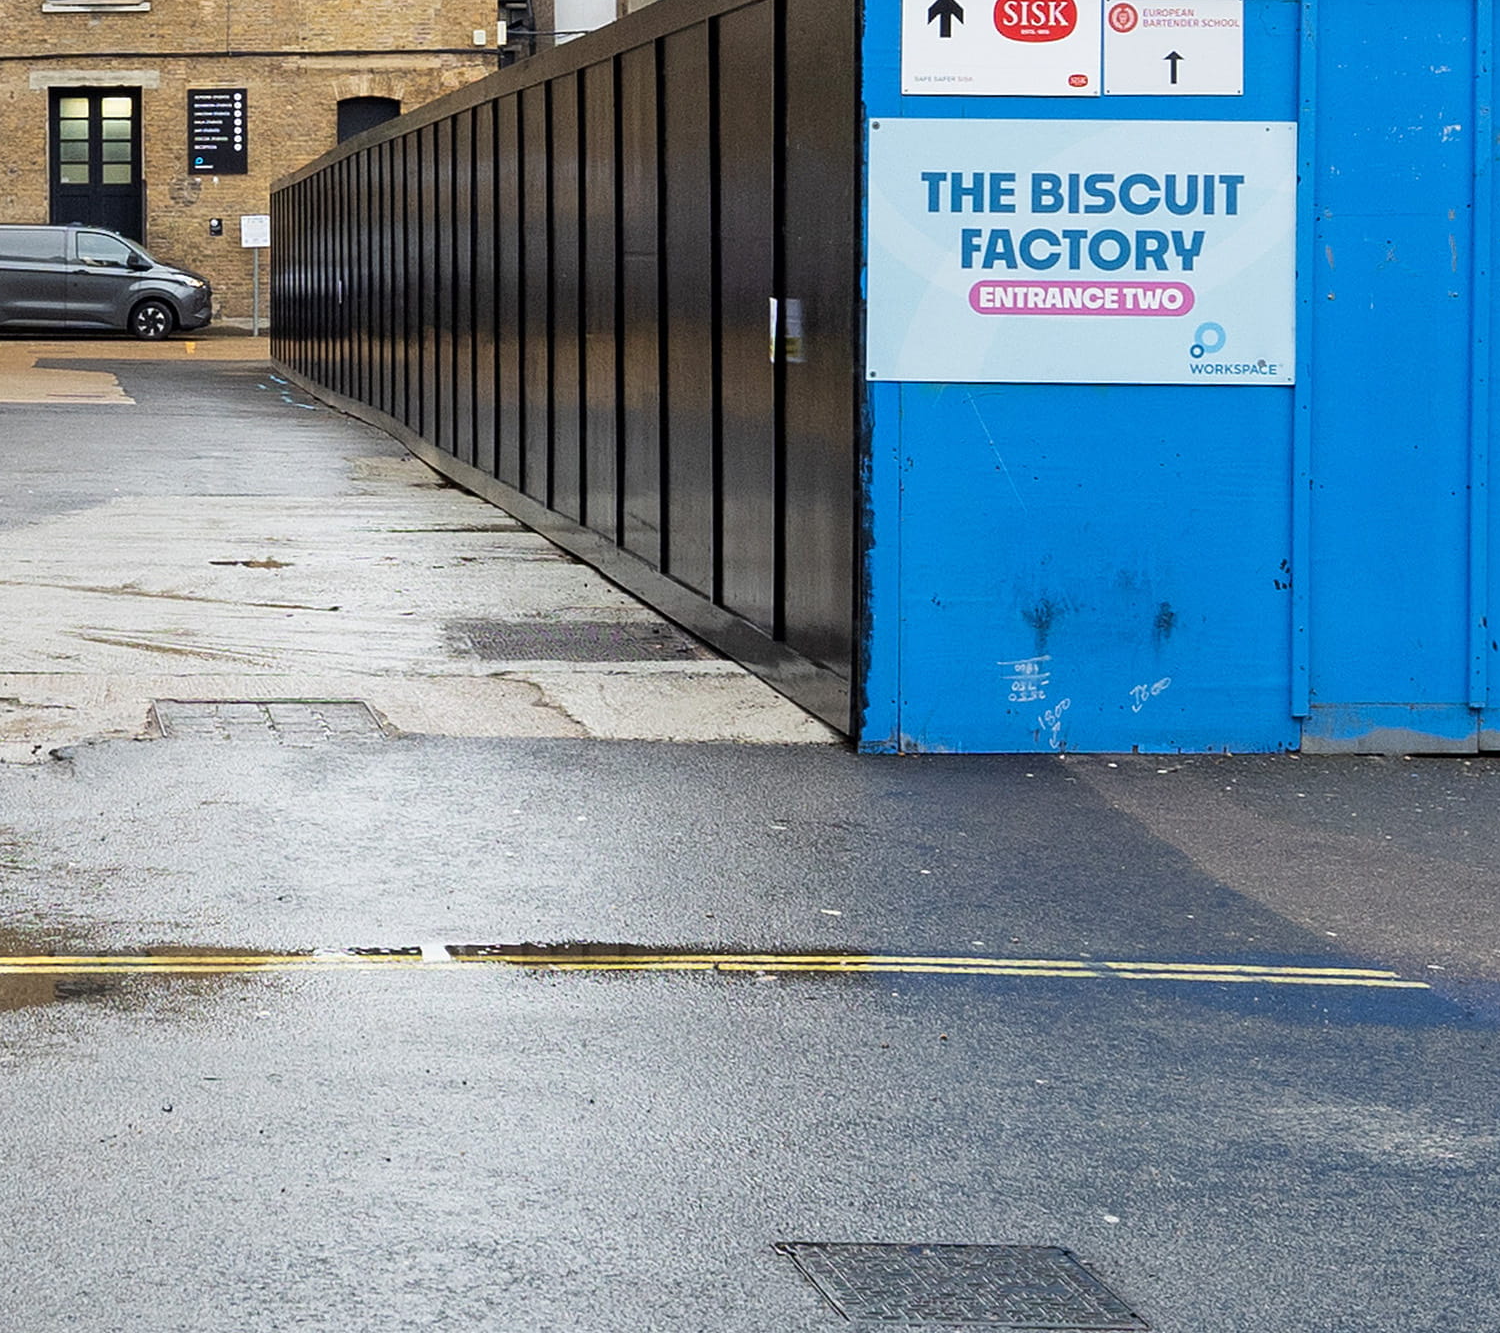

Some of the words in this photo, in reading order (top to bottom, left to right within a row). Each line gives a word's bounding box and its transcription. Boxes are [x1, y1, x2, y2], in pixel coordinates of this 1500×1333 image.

[1002, 0, 1070, 27] SISK
[1142, 8, 1195, 18] EUROPEAN
[1142, 18, 1200, 28] BARTENDER
[1201, 18, 1241, 28] SCHOOL
[921, 171, 1017, 214] THE
[1030, 172, 1246, 216] BISCUIT
[960, 228, 1206, 272] FACTORY
[979, 286, 1119, 310] ENTRANCE
[1123, 287, 1184, 310] TWO
[1189, 362, 1278, 376] WORKSPACE
